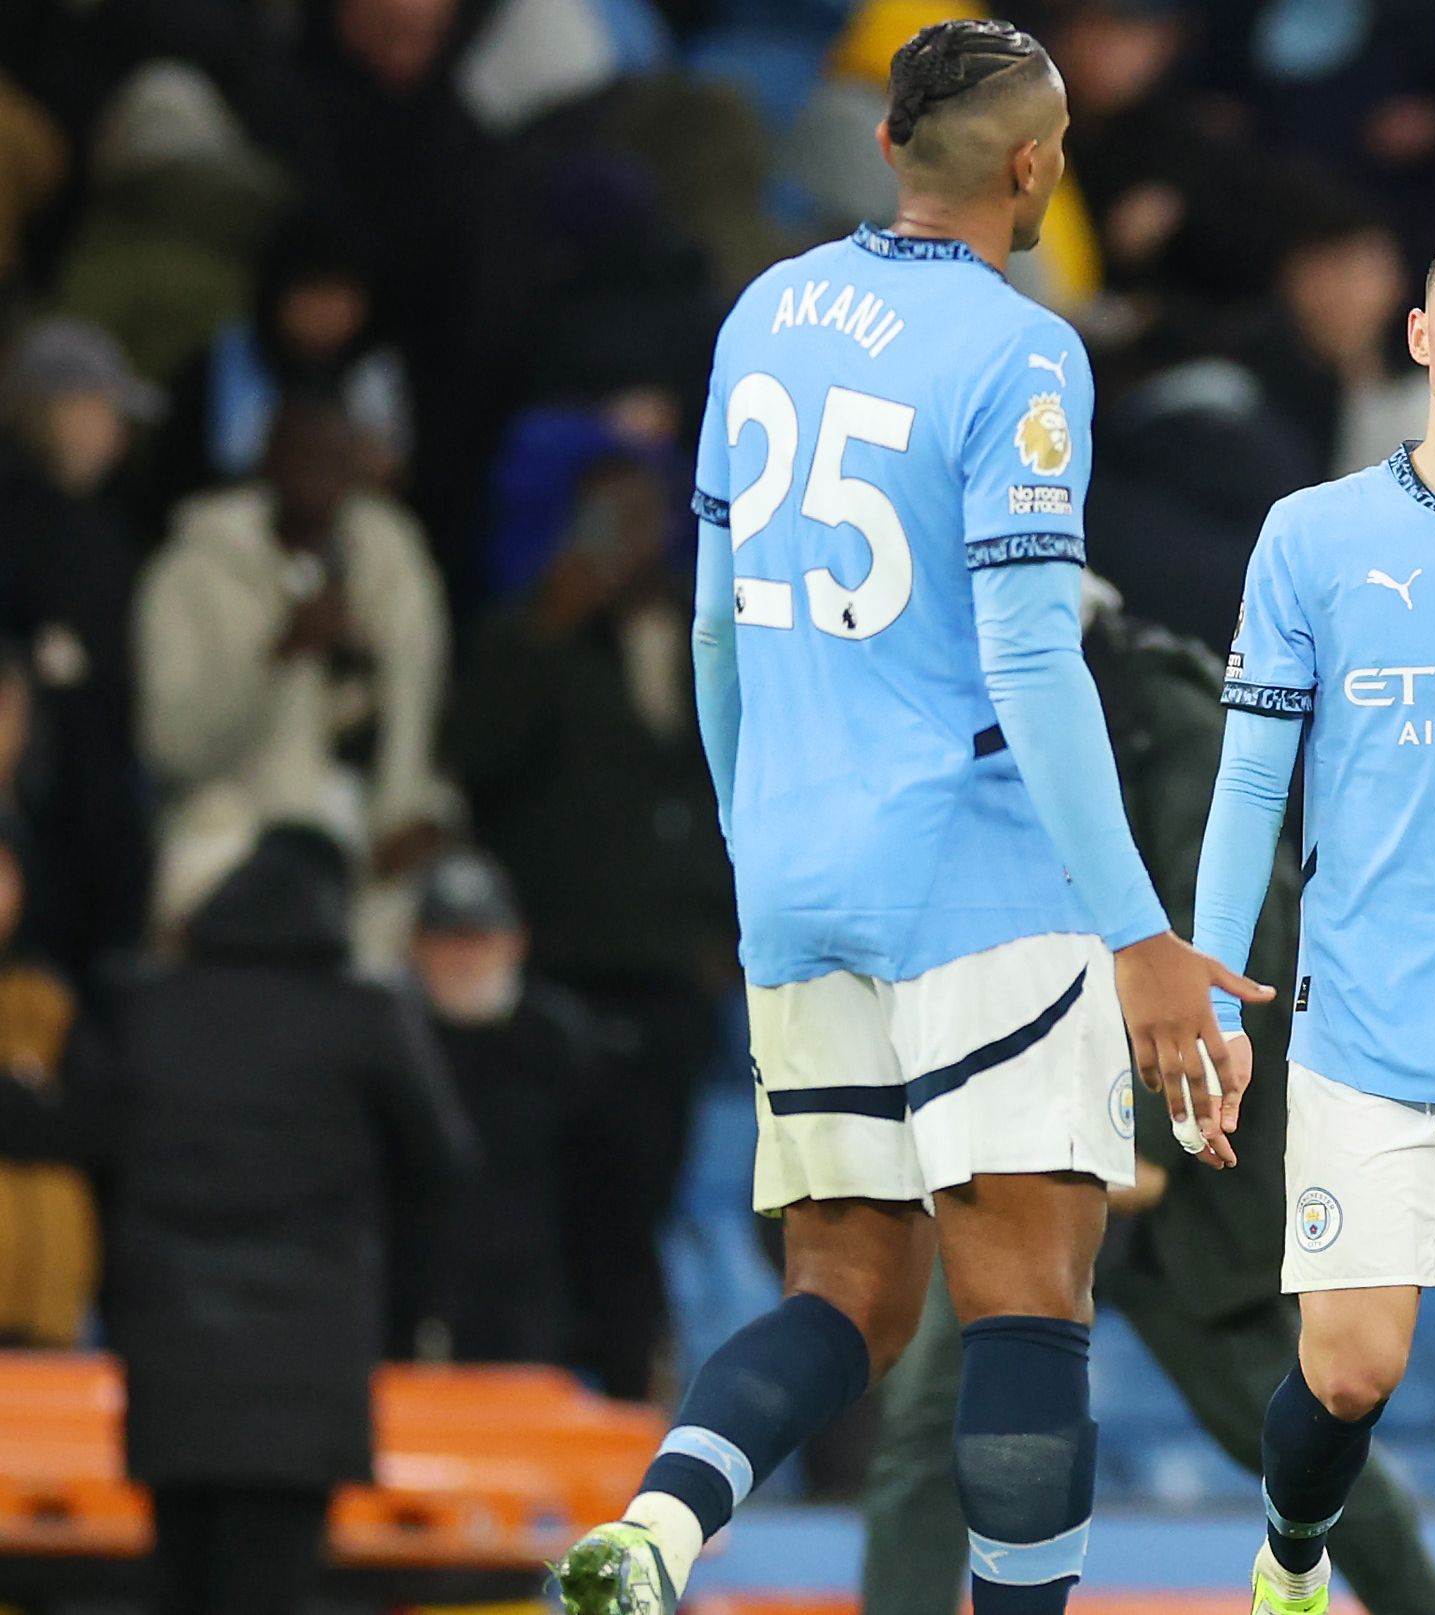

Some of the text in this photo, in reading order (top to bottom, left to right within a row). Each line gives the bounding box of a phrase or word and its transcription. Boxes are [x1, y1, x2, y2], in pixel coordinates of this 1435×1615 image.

[771, 279, 905, 359] AKANJI
[727, 372, 916, 641] 25
[1008, 486, 1069, 503] No room
